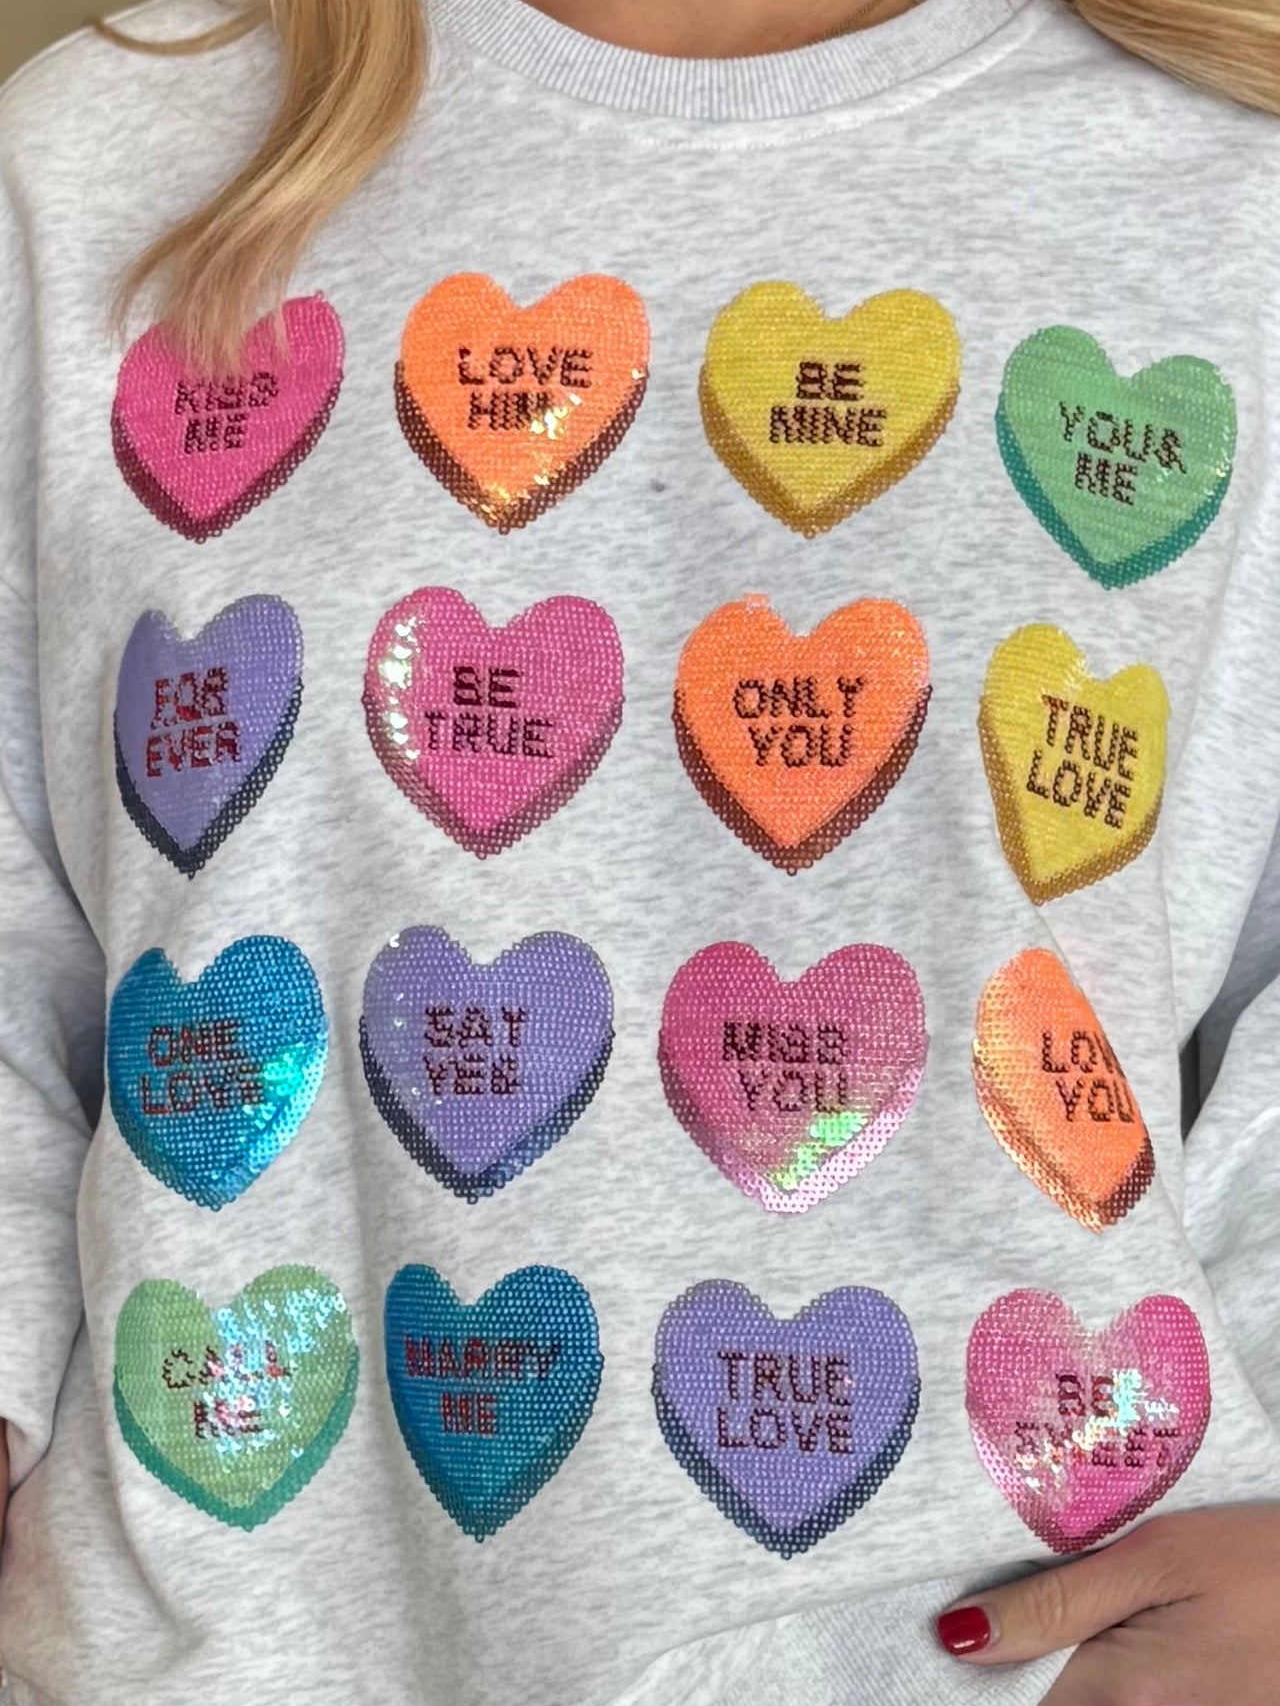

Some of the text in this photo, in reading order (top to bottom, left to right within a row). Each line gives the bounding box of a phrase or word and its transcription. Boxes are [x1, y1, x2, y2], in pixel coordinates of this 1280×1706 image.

[457, 345, 593, 388] LOVE
[795, 361, 865, 401] BE
[183, 412, 249, 455] ME
[769, 404, 888, 448] MINE
[1074, 451, 1138, 506] ME
[150, 666, 230, 731] FOR
[451, 664, 525, 709] BE
[730, 675, 868, 720] ONLY
[146, 720, 243, 779] EVER
[423, 709, 554, 760] TRUE
[747, 723, 855, 768] YOU
[1041, 693, 1138, 785] TRUE
[1025, 748, 1131, 830] LOVE
[147, 1018, 244, 1069] ONE
[423, 1004, 528, 1049] SAY
[722, 1021, 852, 1065] MISS
[139, 1062, 265, 1116] LOVE
[422, 1052, 522, 1097] YES
[738, 1069, 850, 1113] YOU
[1055, 1077, 1136, 1124] YOU
[717, 1349, 852, 1408] TRUE
[1055, 1373, 1122, 1417] BE
[192, 1397, 263, 1439] ME
[439, 1390, 499, 1437] ME
[716, 1405, 854, 1455] LOVE
